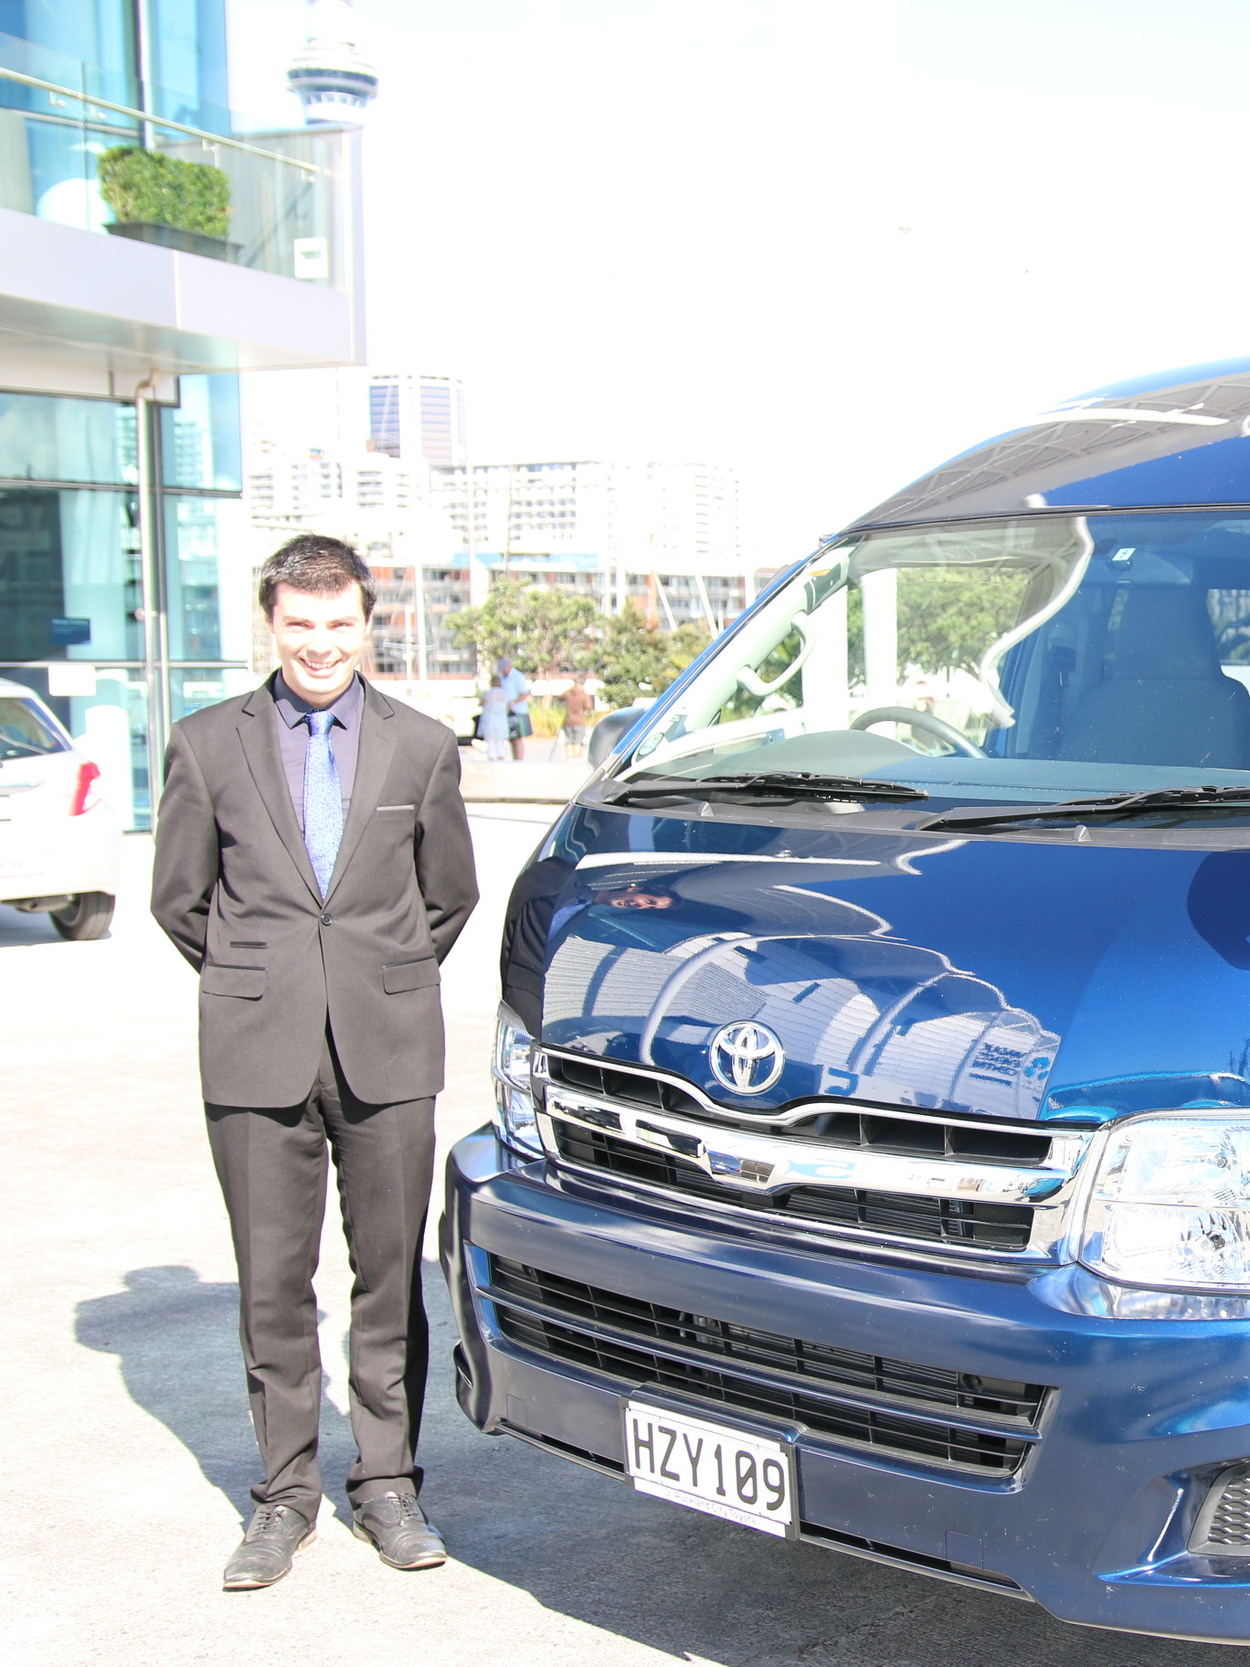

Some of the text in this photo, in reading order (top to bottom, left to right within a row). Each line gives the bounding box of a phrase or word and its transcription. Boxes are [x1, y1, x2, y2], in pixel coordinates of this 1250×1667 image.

[633, 1418, 785, 1511] HZY109
[675, 1492, 756, 1524] Auckland City Toyota
